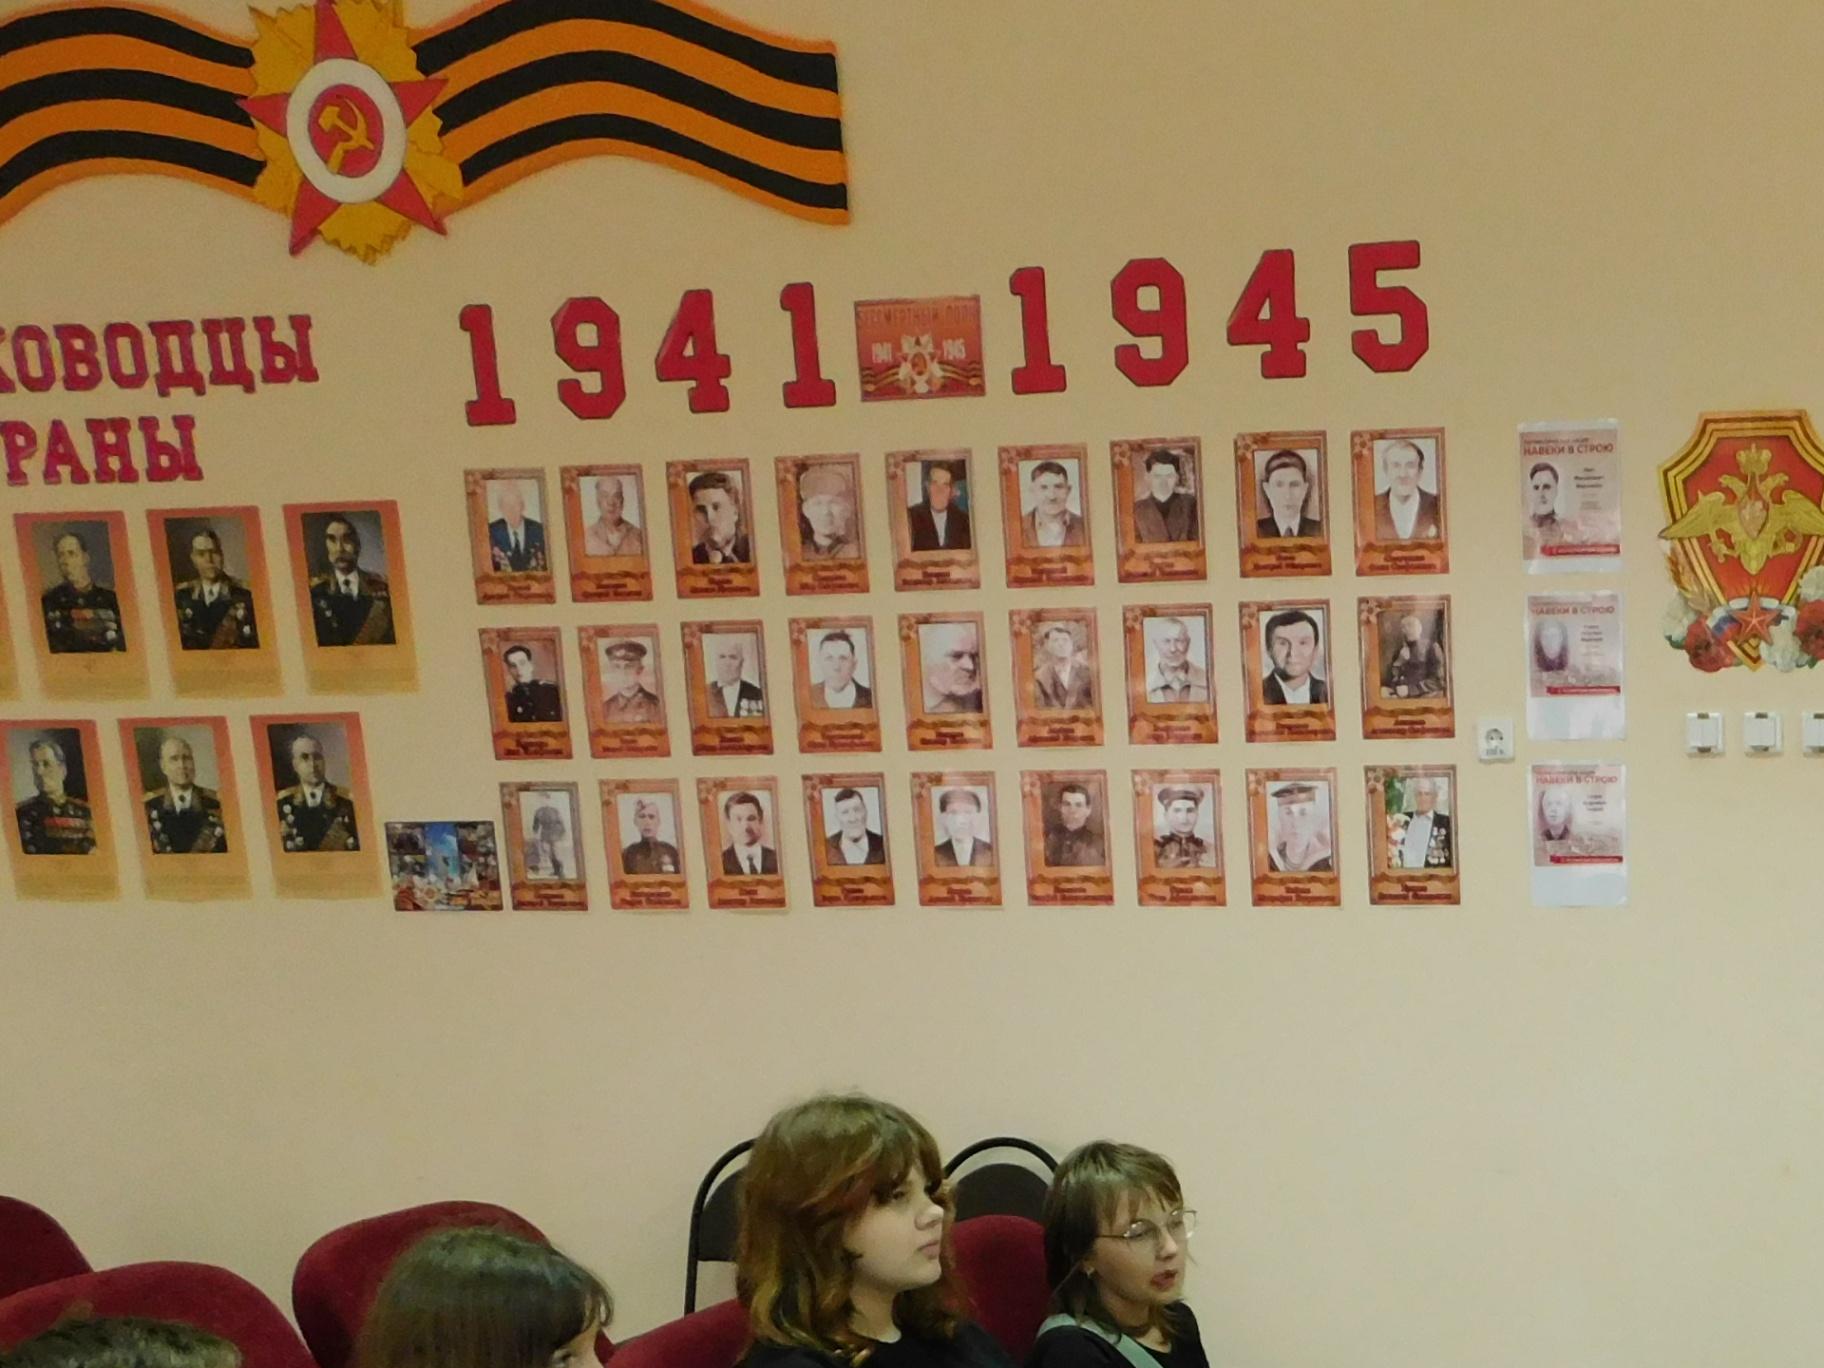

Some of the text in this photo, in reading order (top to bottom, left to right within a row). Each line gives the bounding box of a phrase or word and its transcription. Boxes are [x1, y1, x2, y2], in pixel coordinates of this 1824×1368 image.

[0, 314, 319, 398] ОВОДЦЫ
[459, 281, 837, 427] 1941
[1008, 240, 1429, 395] 1945
[0, 414, 204, 486] РАНЫ
[1567, 445, 1575, 454] В
[1577, 443, 1614, 454] СТРОЮ
